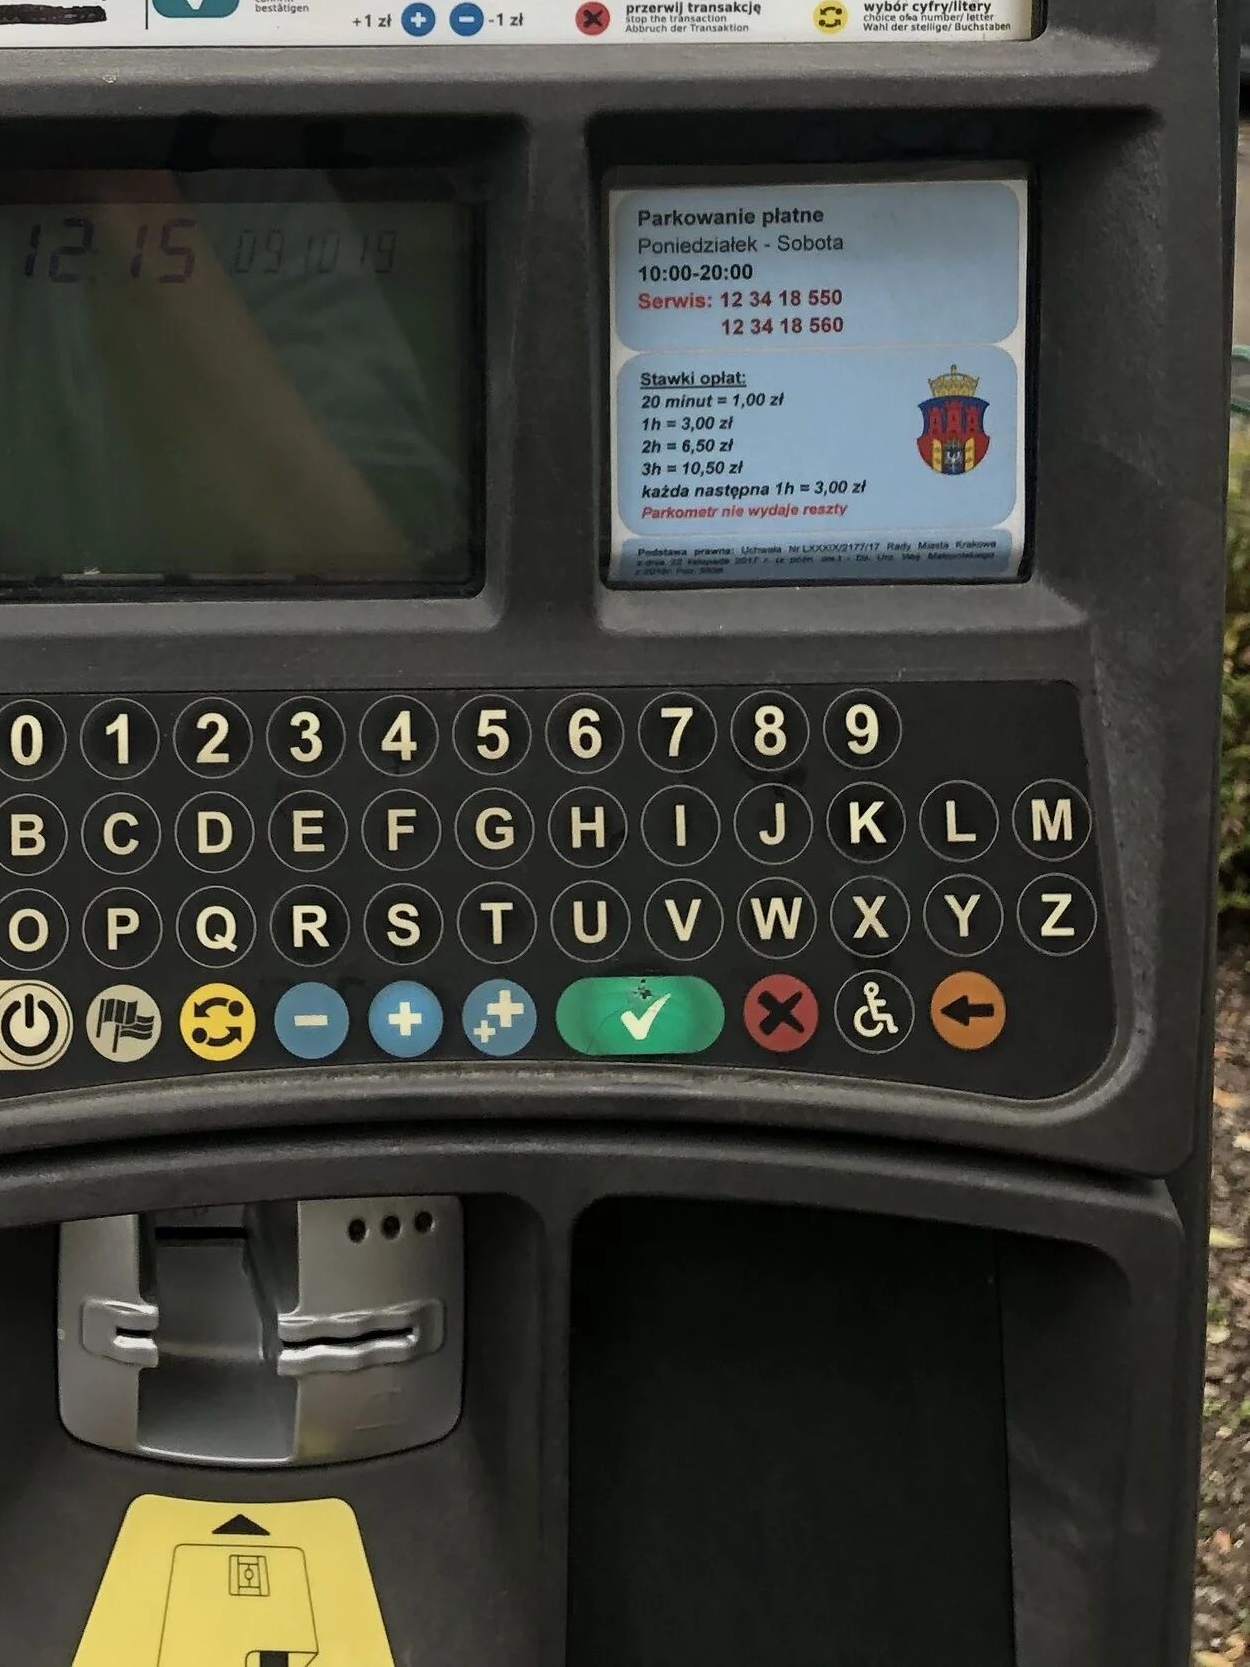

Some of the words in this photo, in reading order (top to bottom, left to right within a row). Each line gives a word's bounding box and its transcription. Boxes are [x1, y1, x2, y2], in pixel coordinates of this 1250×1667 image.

[864, 0, 908, 13] wybór
[912, 0, 992, 15] cyfry/litery
[638, 208, 755, 227] Parkowanie
[762, 207, 824, 227] płatne
[638, 236, 758, 254] Poniedziałek
[777, 234, 844, 251] Sobota
[638, 264, 753, 281] 10:00-20:00
[638, 292, 713, 310] Serwis:
[720, 292, 743, 307] 12
[750, 291, 772, 307] 34
[779, 290, 801, 307] 18
[808, 289, 843, 306] 550
[722, 319, 744, 335] 12
[751, 318, 773, 335] 34
[780, 317, 802, 335] 18
[809, 317, 844, 333] 560
[640, 372, 695, 386] Stawki
[700, 371, 747, 387] opłat:
[641, 395, 661, 409] 20
[665, 395, 713, 408] minut
[732, 393, 766, 409] 1,00
[770, 392, 785, 407] zł
[642, 418, 661, 431] 1h
[681, 417, 715, 433] 3,00
[719, 416, 734, 430] zł
[642, 440, 661, 453] 2h
[681, 439, 715, 454] 6,50
[719, 438, 734, 453] zł
[642, 462, 661, 476] 3h
[682, 461, 725, 477] 10,50
[729, 461, 743, 475] zł
[642, 484, 689, 498] każda
[694, 484, 769, 499] następna
[775, 482, 794, 495] 1h
[814, 481, 848, 497] 3,00
[852, 480, 867, 494] zł
[642, 505, 717, 519] Parkometr
[721, 504, 744, 517] nie
[748, 503, 799, 518] wydaje
[803, 504, 848, 516] reszty
[10, 714, 44, 766] 0
[105, 713, 129, 765] 1
[196, 712, 230, 764] 2
[290, 711, 323, 762] 3
[381, 710, 417, 761] 4
[476, 709, 510, 760] 5
[568, 708, 602, 759] 6
[660, 707, 694, 757] 7
[754, 705, 787, 756] 8
[845, 703, 879, 755] 9
[10, 813, 46, 856] B
[103, 811, 139, 856] C
[197, 811, 233, 854] D
[292, 809, 325, 853] E
[387, 808, 417, 851] F
[475, 807, 515, 850] G
[571, 806, 605, 849] H
[675, 804, 686, 847] I
[758, 802, 786, 846] J
[849, 801, 887, 844] K
[945, 800, 977, 842] L
[1031, 798, 1073, 842] M
[8, 908, 49, 952] O
[107, 907, 140, 951] P
[196, 905, 238, 953] Q
[292, 905, 330, 948] R
[386, 903, 421, 947] S
[480, 902, 514, 945] T
[573, 900, 608, 944] U
[664, 898, 702, 942] V
[750, 897, 803, 940] W
[852, 895, 889, 939] X
[944, 894, 981, 937] Y
[1040, 893, 1075, 937] Z
